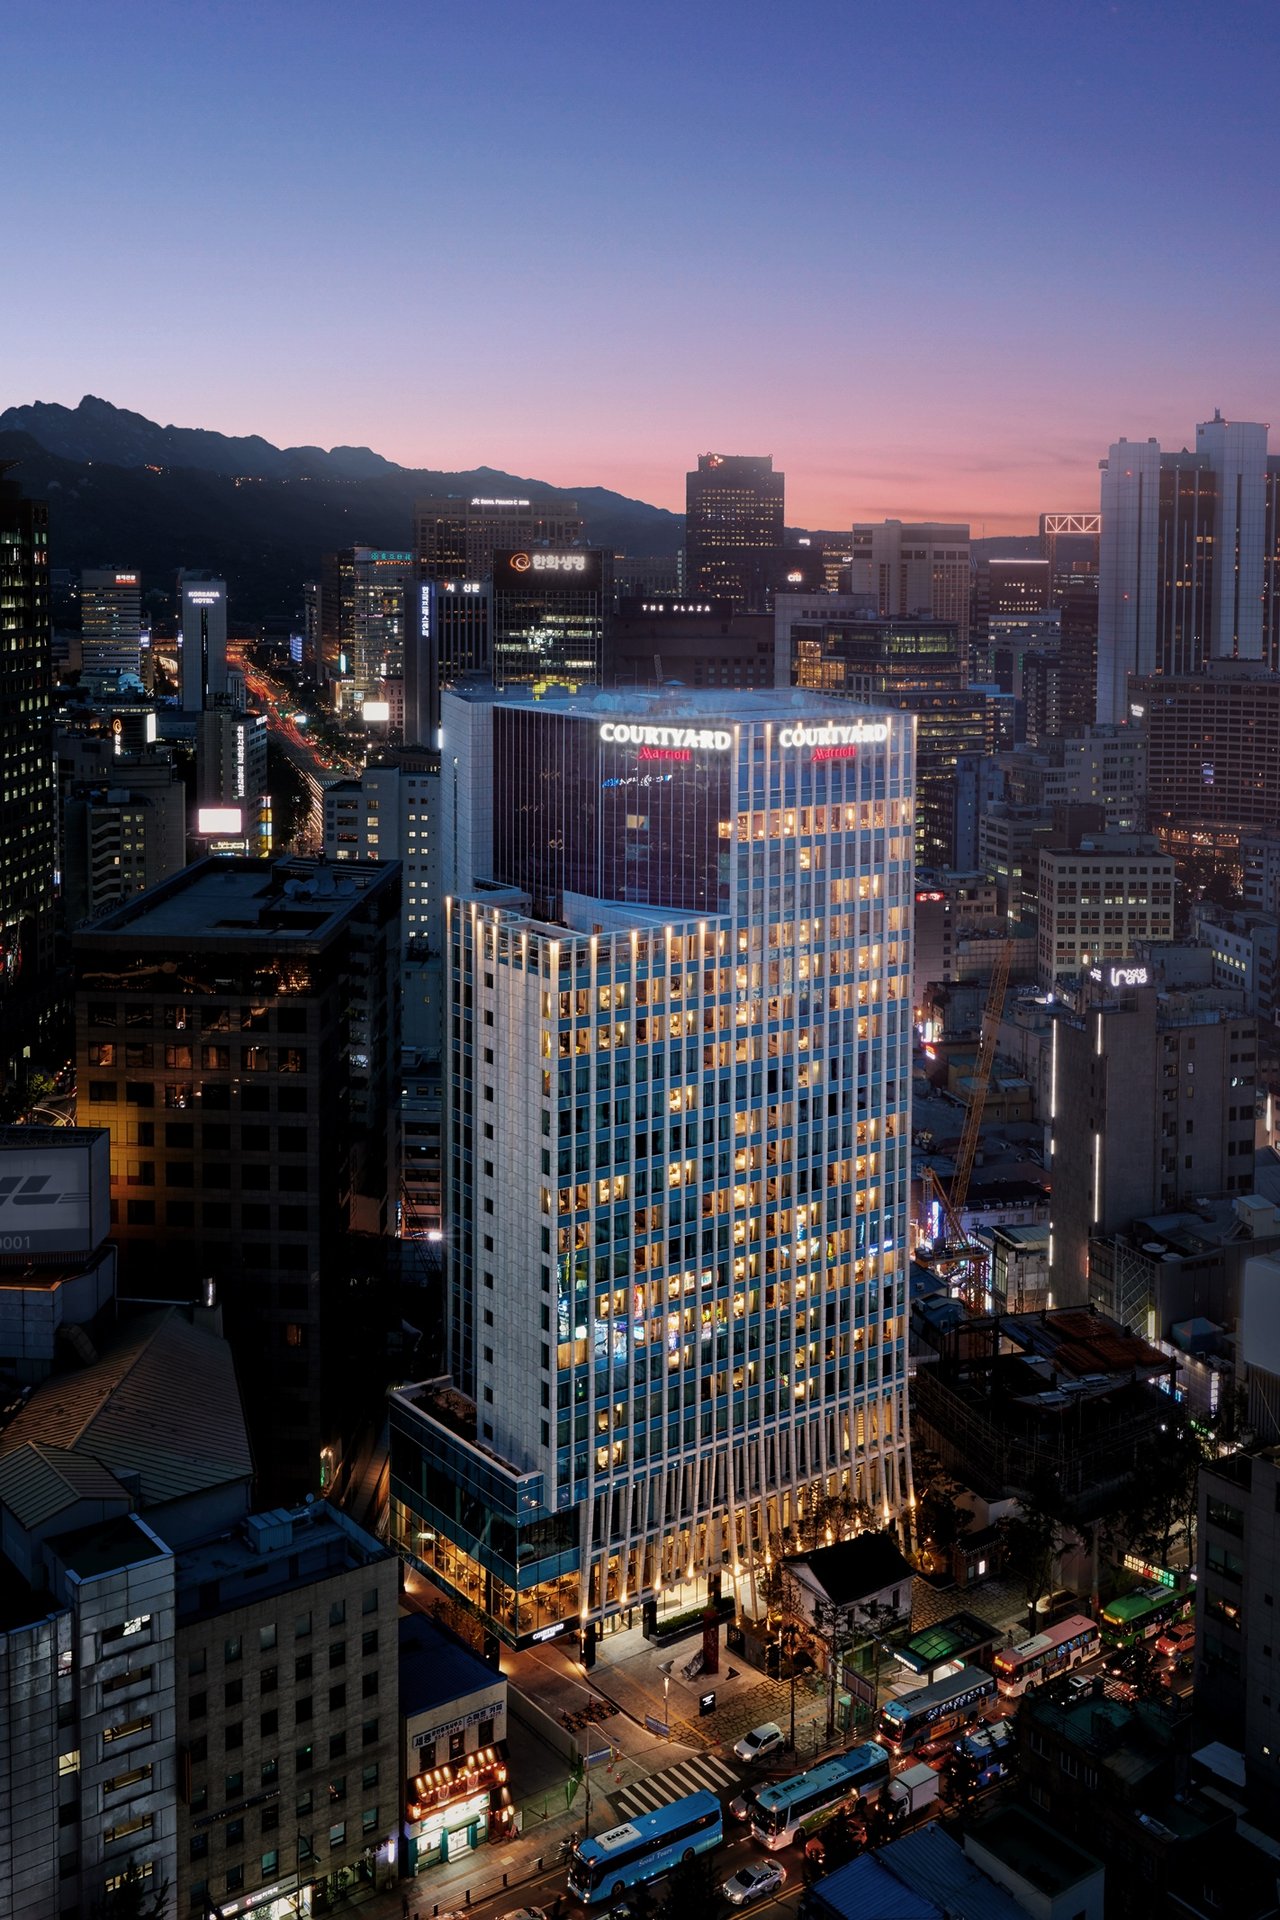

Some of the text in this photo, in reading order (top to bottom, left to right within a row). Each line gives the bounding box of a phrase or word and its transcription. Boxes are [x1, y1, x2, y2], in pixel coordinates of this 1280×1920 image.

[526, 555, 585, 570] 한화생명
[600, 723, 731, 750] COURTYARD
[779, 724, 887, 747] COURTYARD
[638, 747, 691, 761] Marriott
[812, 746, 857, 761] Marriott
[0, 1236, 30, 1249] 001
